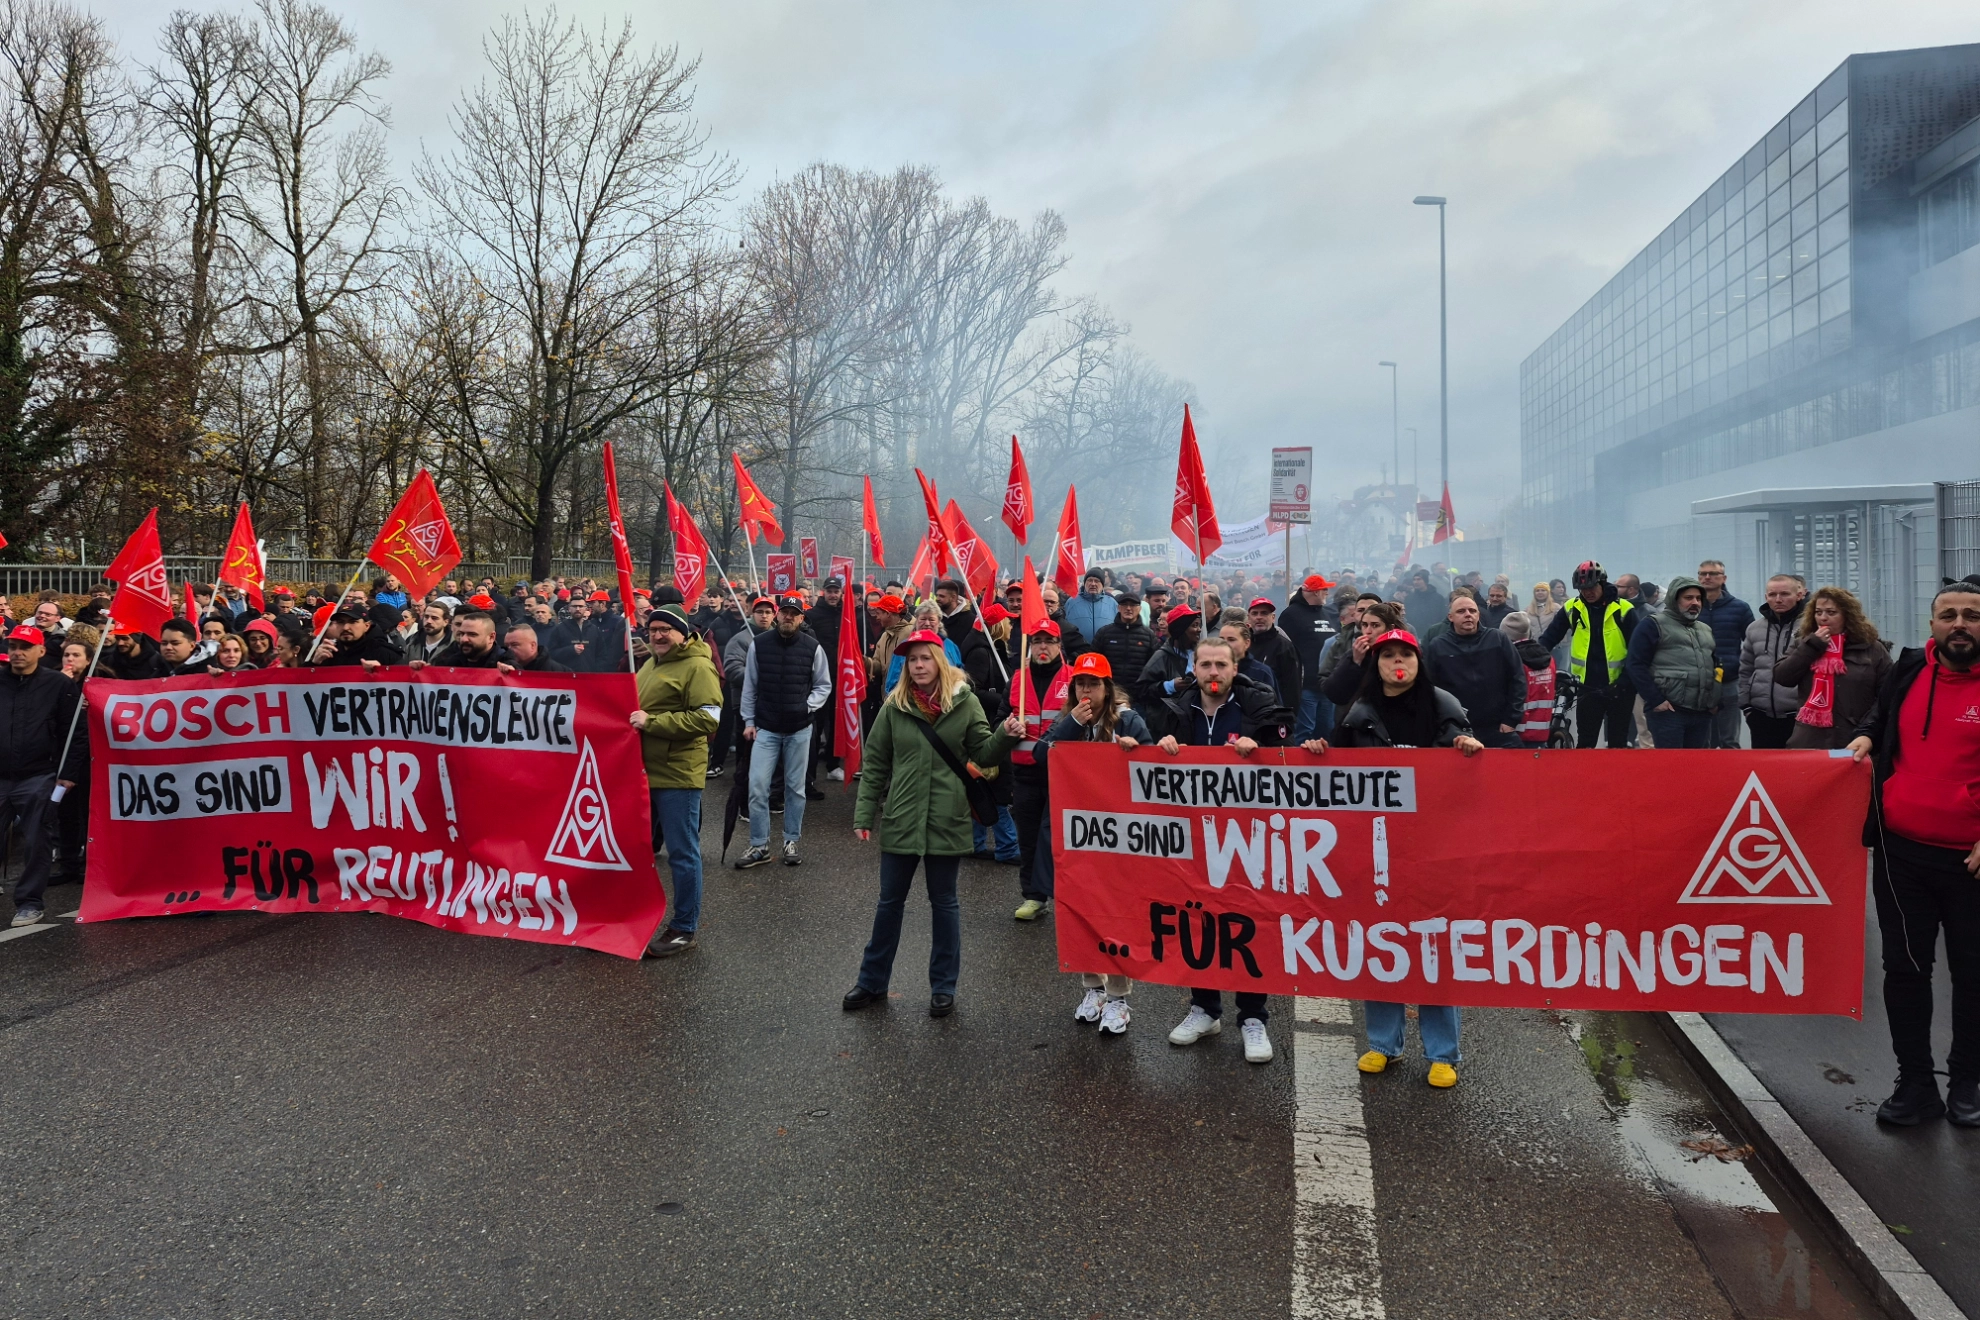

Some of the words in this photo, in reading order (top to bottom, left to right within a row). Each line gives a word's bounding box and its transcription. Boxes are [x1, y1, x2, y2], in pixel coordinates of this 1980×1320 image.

[1095, 543, 1168, 561] KAMPFBER
[111, 691, 291, 743] BOSCH
[303, 685, 572, 746] VERTRAUENSLEUTE
[118, 772, 180, 817] DAS
[195, 764, 281, 813] SIND
[1136, 767, 1403, 807] VERTRAUENSLEUTE
[1071, 815, 1118, 848] DAS
[1127, 822, 1185, 857] SIND
[222, 840, 320, 904] FÜR
[333, 845, 578, 935] REUTLINGEN
[1150, 900, 1263, 978] FÜR
